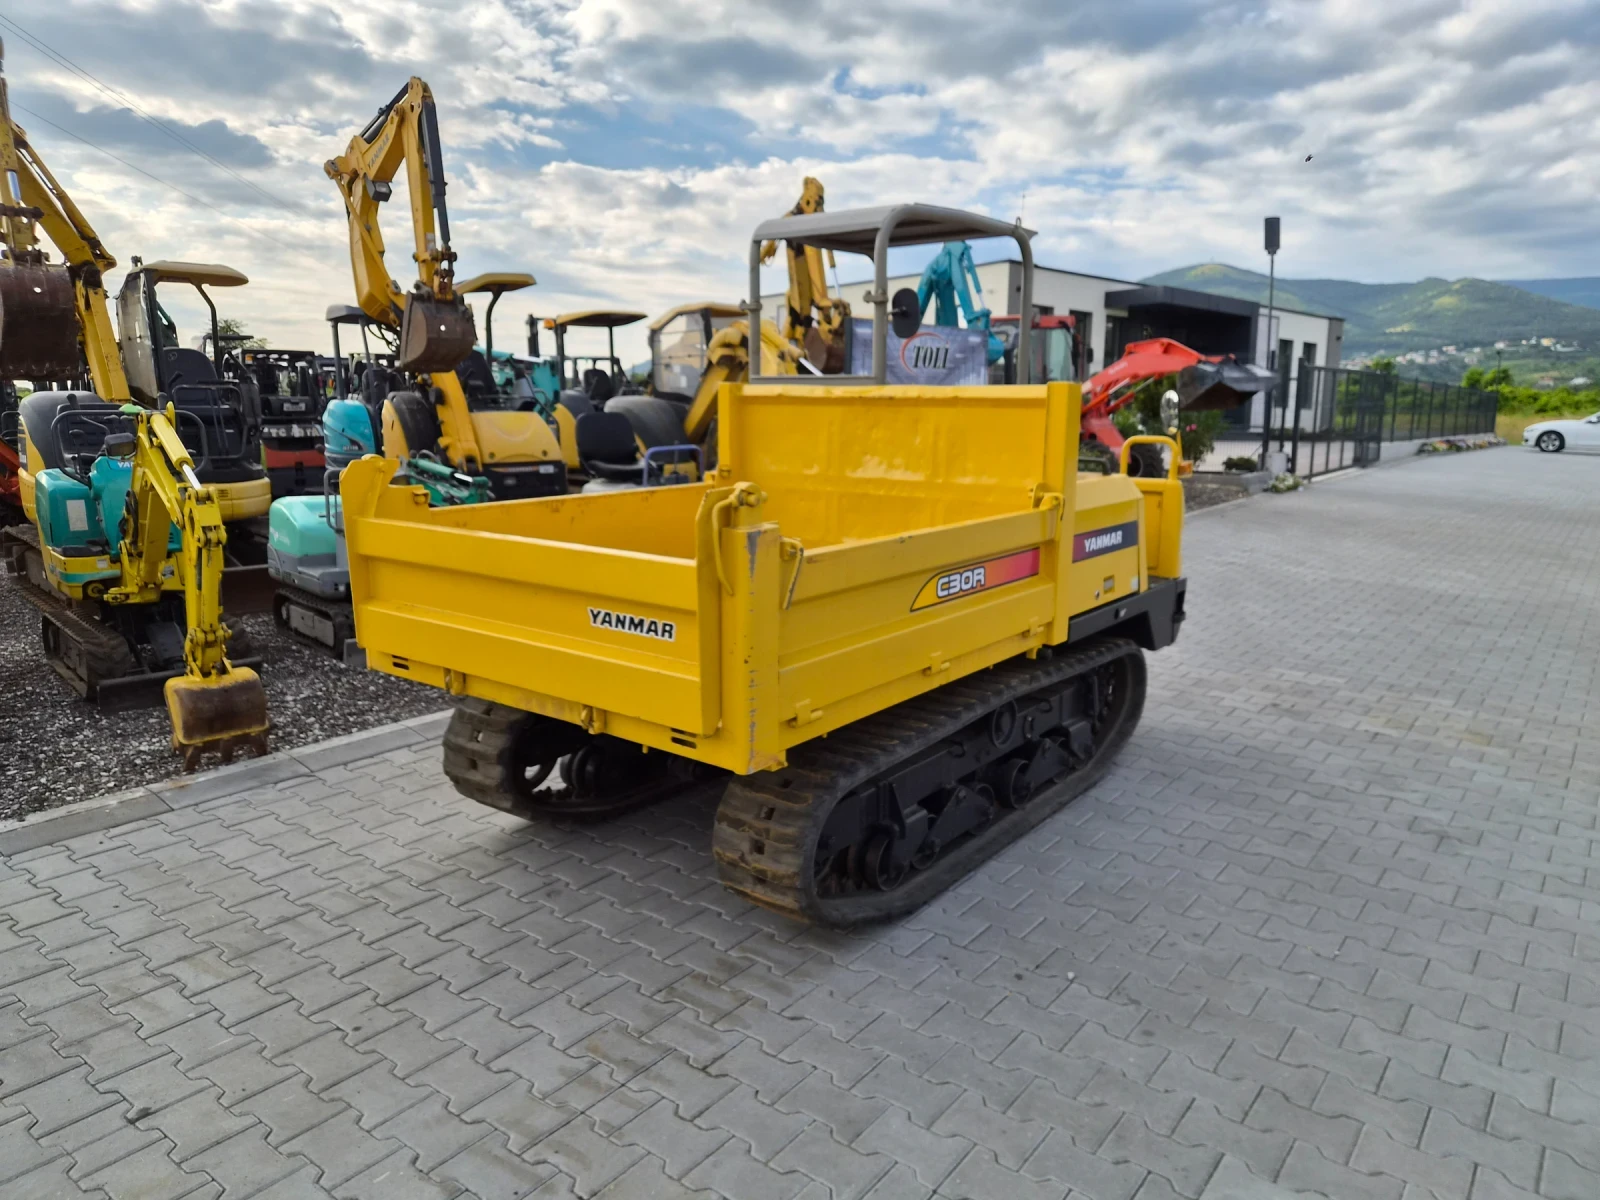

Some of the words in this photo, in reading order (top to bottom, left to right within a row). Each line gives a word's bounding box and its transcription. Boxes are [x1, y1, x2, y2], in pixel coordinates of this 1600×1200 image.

[1084, 530, 1123, 553] YANMAR
[937, 566, 986, 599] C30R
[588, 607, 675, 640] YANMAR
